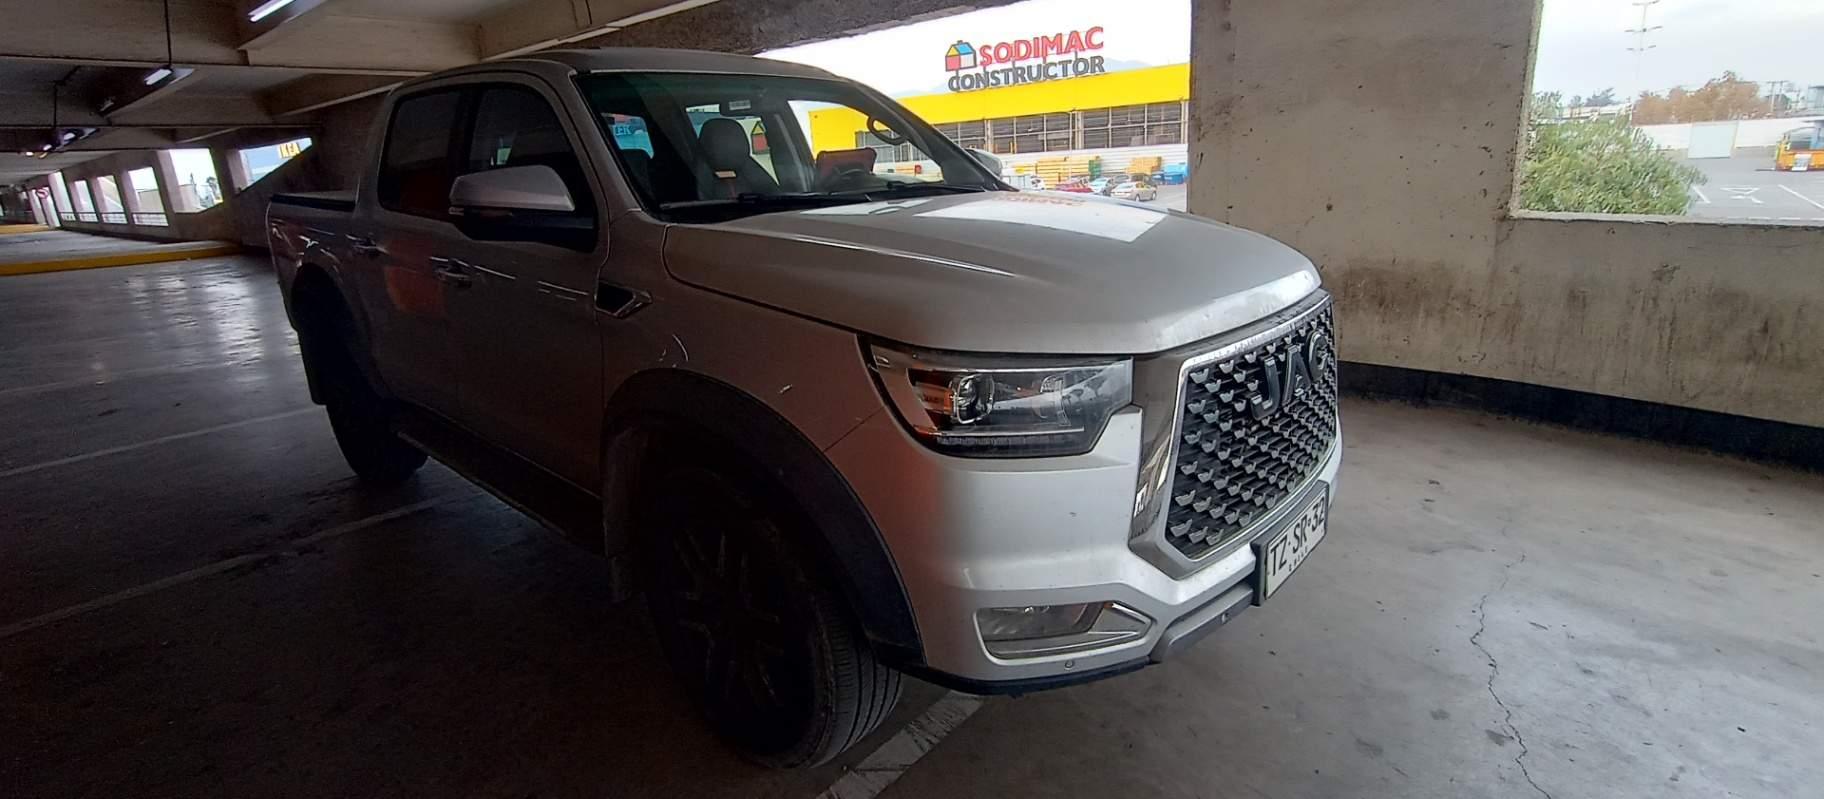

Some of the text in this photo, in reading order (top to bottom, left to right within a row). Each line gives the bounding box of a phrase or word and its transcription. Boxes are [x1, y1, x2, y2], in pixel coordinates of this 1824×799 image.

[979, 26, 1104, 66] SODIMAC
[948, 55, 1105, 92] CONSTRUCTOR
[1250, 331, 1329, 420] JAC
